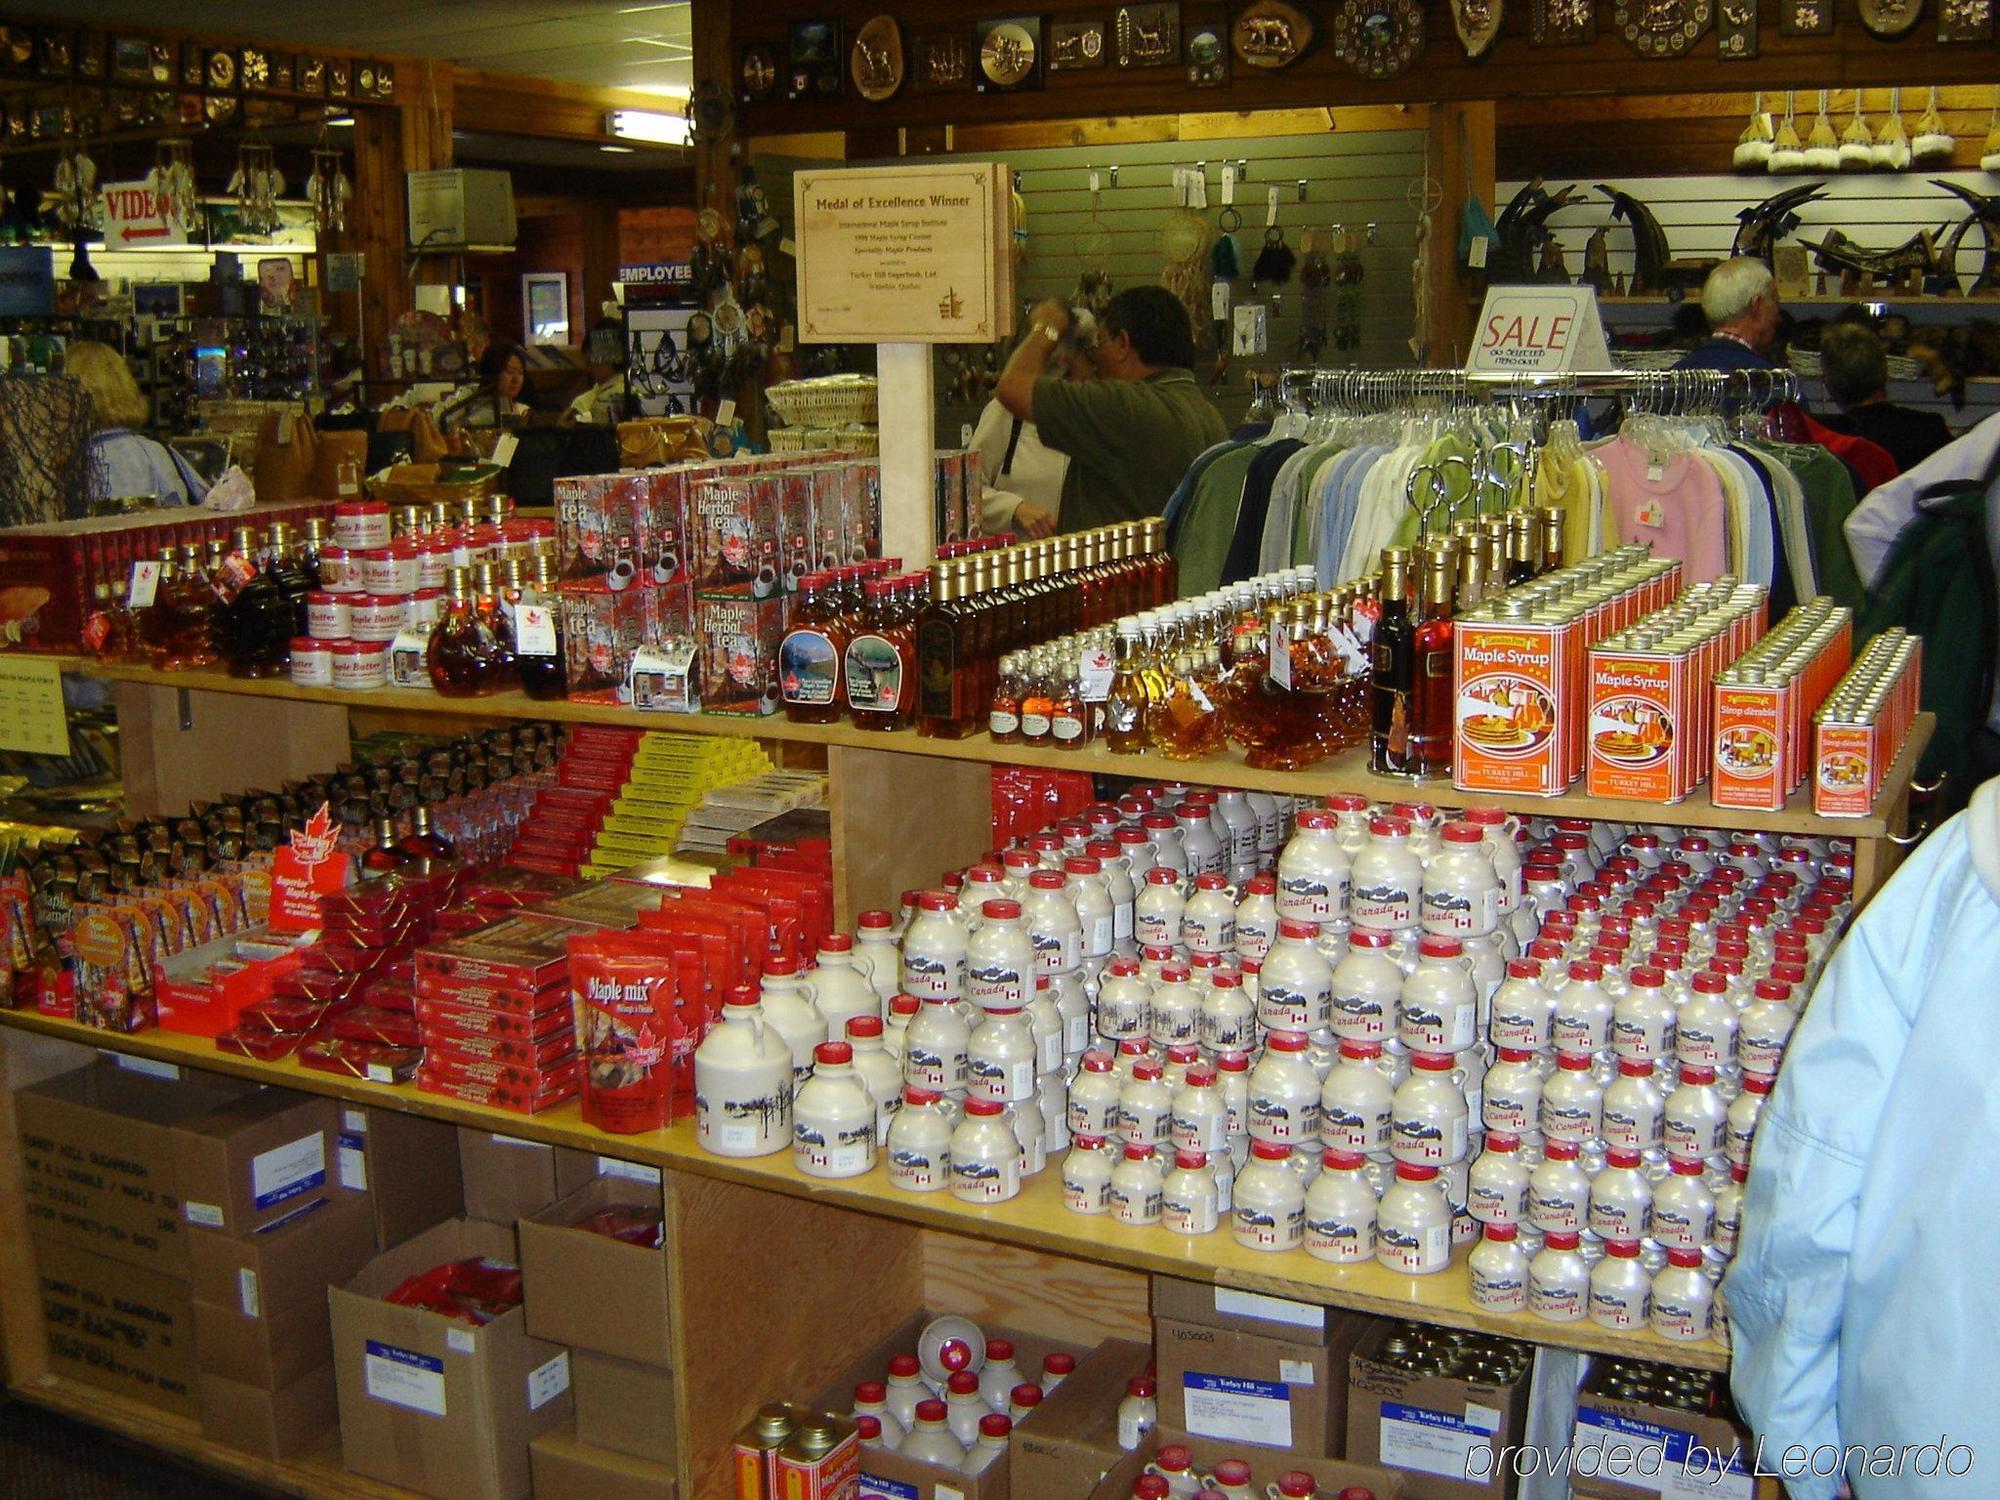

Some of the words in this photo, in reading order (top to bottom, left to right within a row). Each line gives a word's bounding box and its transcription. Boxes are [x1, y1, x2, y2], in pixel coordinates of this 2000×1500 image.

[816, 198, 848, 210] Medal
[852, 197, 863, 209] of
[868, 196, 926, 208] Excellence
[929, 194, 970, 206] Winner
[880, 220, 898, 229] Maple
[900, 220, 920, 229] Syrup
[1482, 315, 1570, 350] SALE
[558, 486, 588, 500] Maple
[704, 486, 738, 501] Maple
[562, 503, 586, 520] tea
[698, 501, 734, 515] Herbal
[710, 516, 730, 529] tea
[710, 605, 746, 620] Maple
[571, 617, 596, 635] tea
[704, 619, 741, 632] Herbal
[717, 634, 737, 647] tea
[1464, 647, 1506, 665] Maple
[1507, 650, 1550, 667] Syrup
[1596, 672, 1632, 688] Maple
[1633, 676, 1669, 691] Syrup
[1720, 705, 1743, 716] Sirop
[1482, 768, 1510, 776] TURKEY
[1512, 770, 1529, 778] HILL
[1640, 781, 1656, 789] HILL
[1356, 904, 1394, 916] Canada
[588, 976, 622, 1004] Maple
[624, 979, 648, 1001] mix
[971, 984, 1004, 996] Canada
[1500, 1026, 1530, 1038] Canada
[1490, 1110, 1520, 1120] Canada
[1556, 1120, 1588, 1132] Canada
[1472, 1201, 1500, 1210] Canada
[1540, 1210, 1572, 1221] Canada
[1656, 1224, 1686, 1235] Canada
[1488, 1290, 1519, 1303] Canada
[1543, 1298, 1576, 1311] Canada
[1656, 1318, 1688, 1328] Canada
[1220, 1378, 1242, 1389] Turkey
[1242, 1382, 1255, 1390] Hill
[1419, 1410, 1441, 1424] Turkey
[1442, 1413, 1456, 1424] Hill
[1620, 1418, 1644, 1432] Turkey
[1646, 1424, 1660, 1434] Hill
